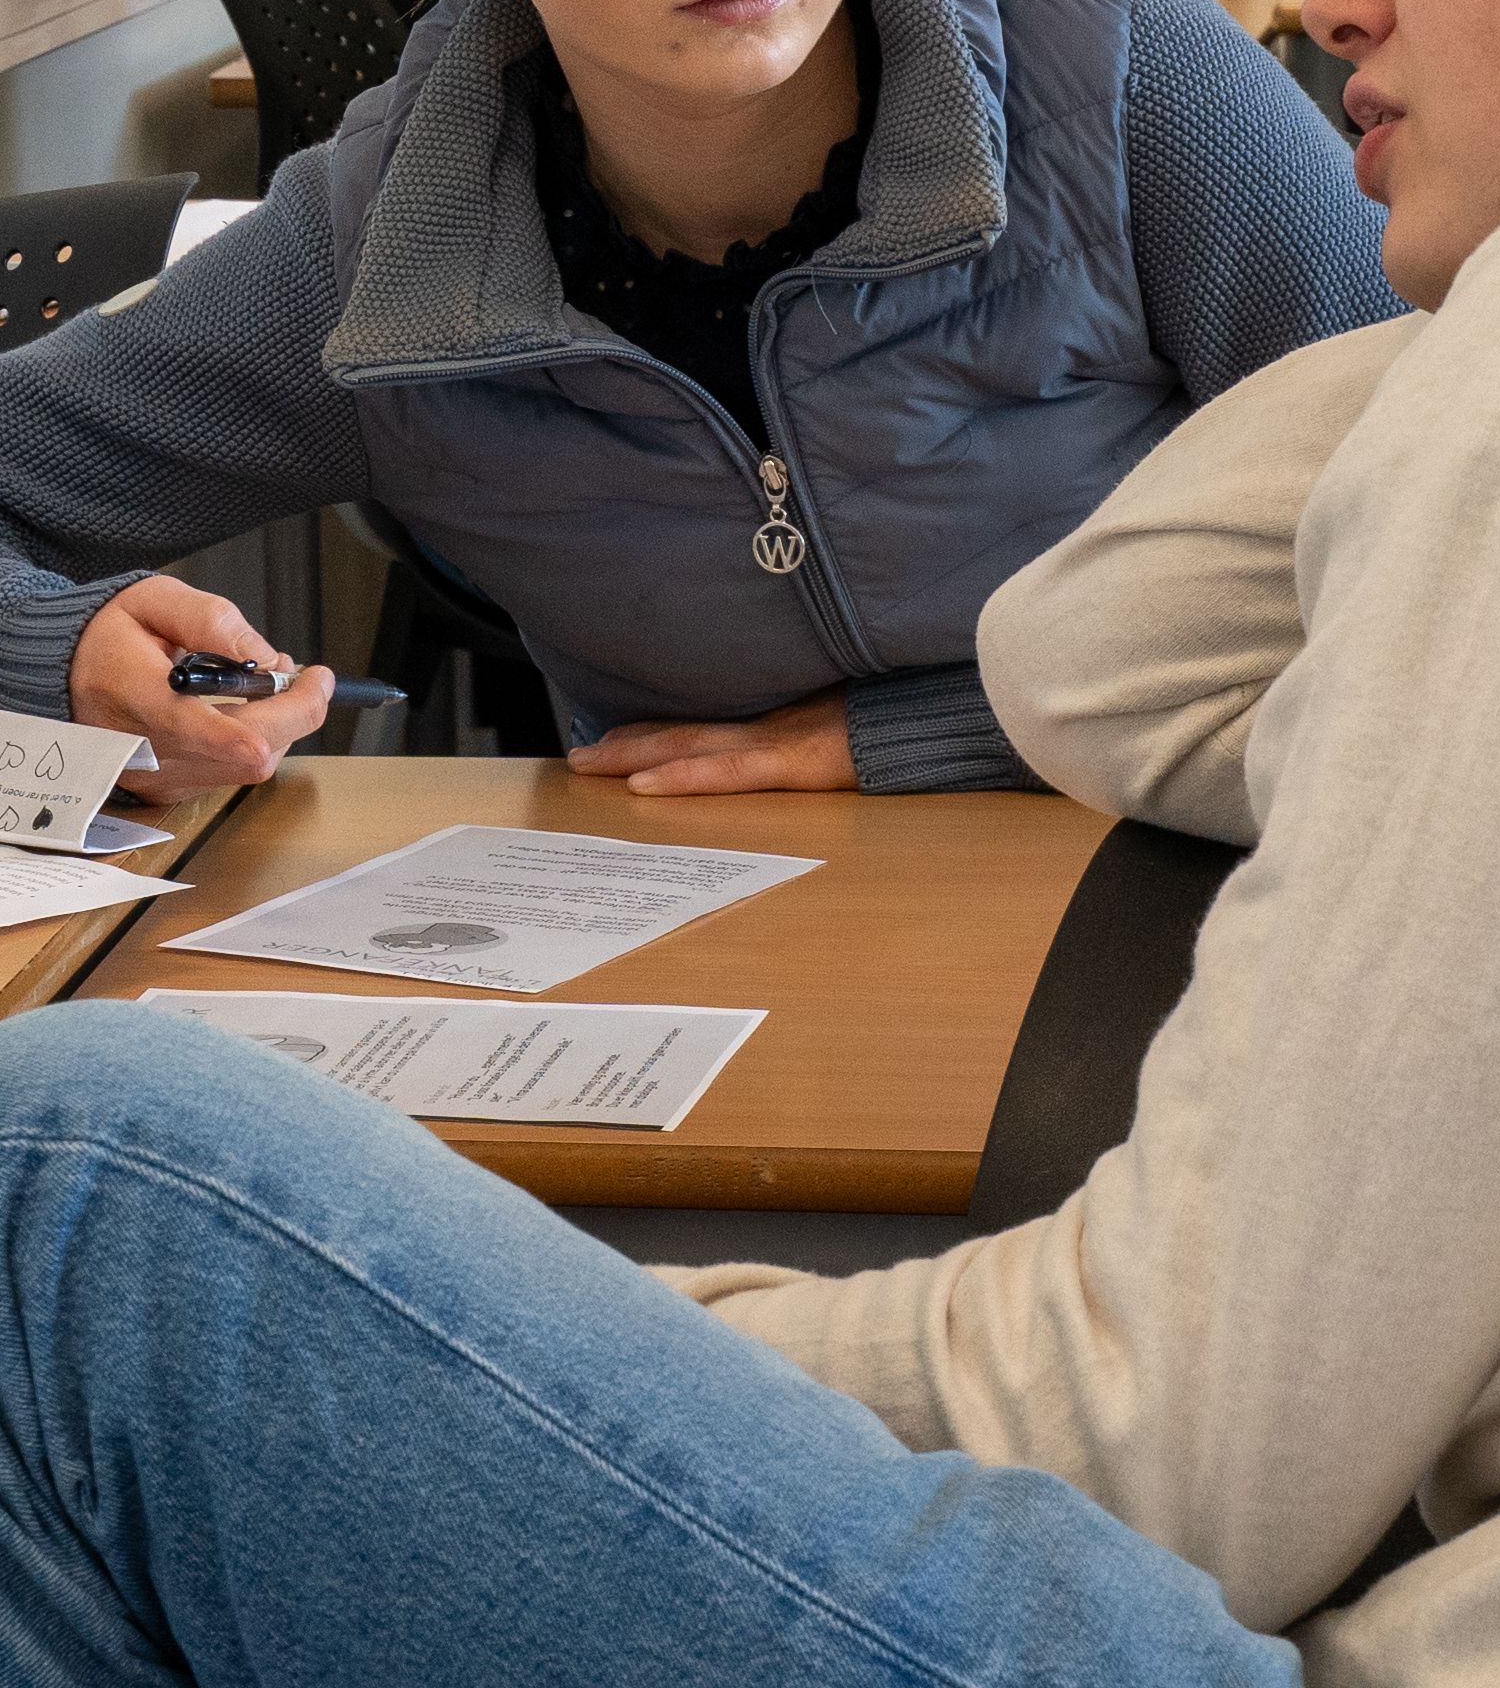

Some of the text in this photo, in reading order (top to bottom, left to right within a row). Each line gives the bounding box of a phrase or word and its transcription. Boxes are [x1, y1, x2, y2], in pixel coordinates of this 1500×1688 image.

[2, 787, 24, 798] noen
[26, 791, 38, 799] rar
[39, 793, 49, 803] så
[50, 794, 59, 802] er
[60, 795, 71, 804] Du
[254, 941, 520, 977] TANKEFANGER
